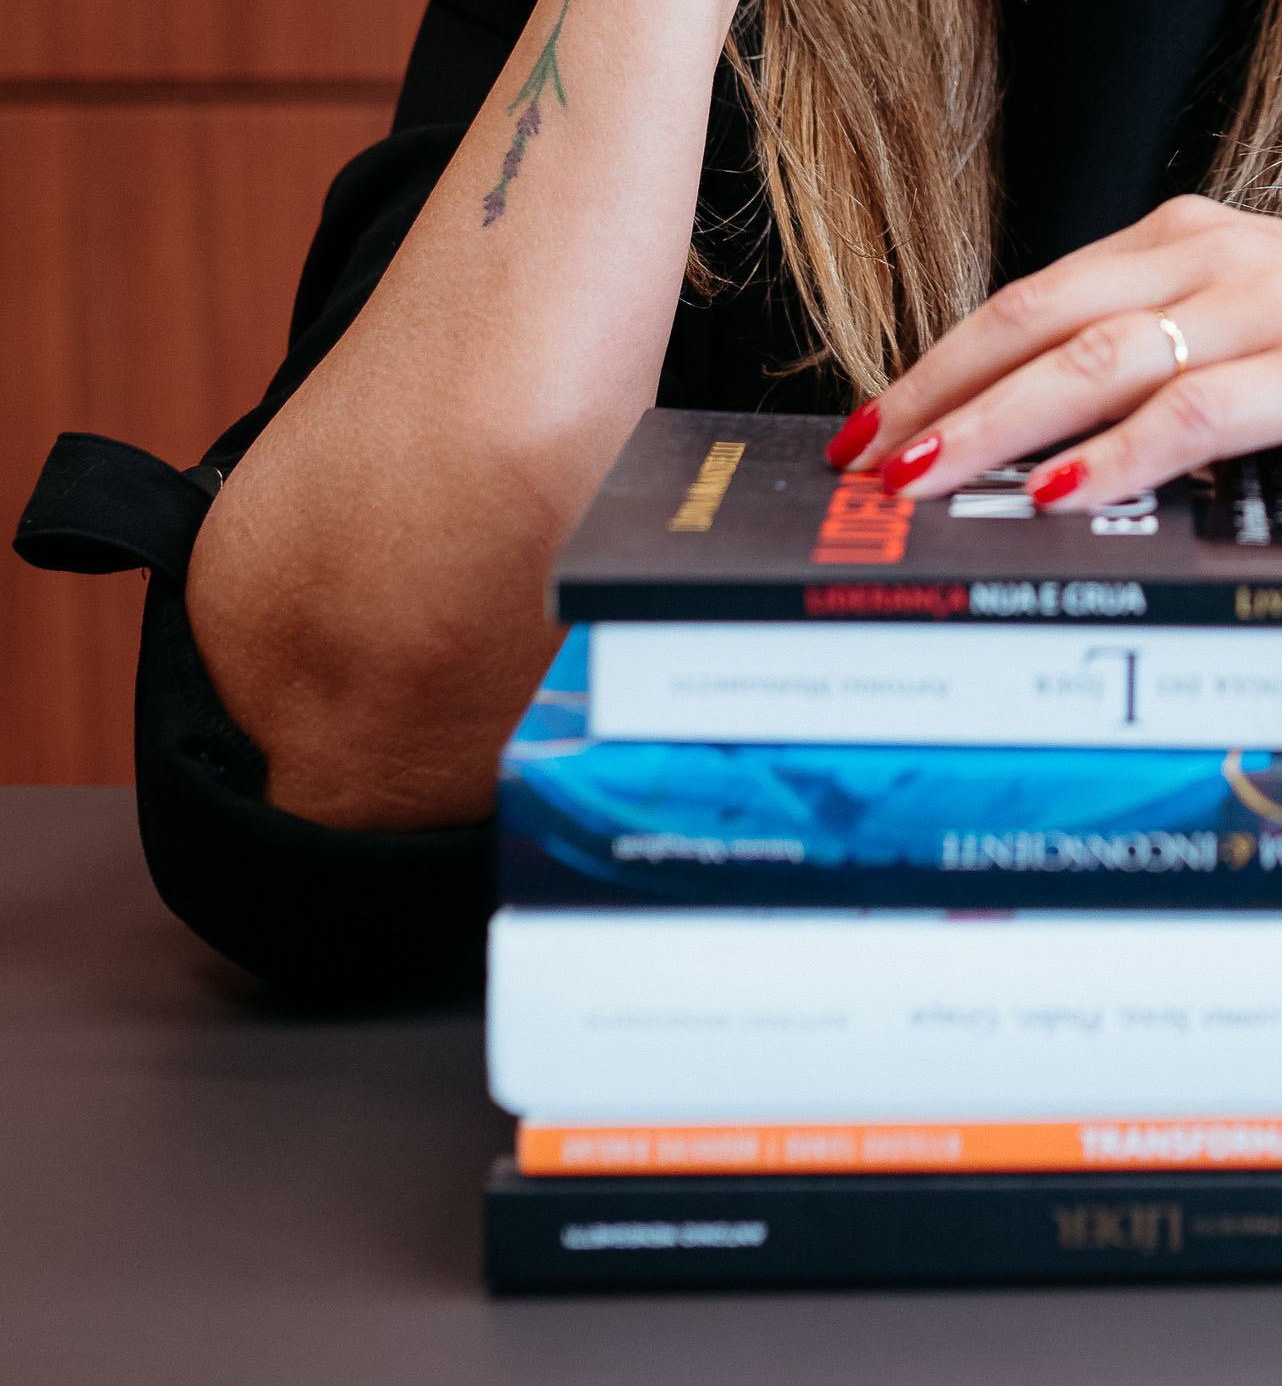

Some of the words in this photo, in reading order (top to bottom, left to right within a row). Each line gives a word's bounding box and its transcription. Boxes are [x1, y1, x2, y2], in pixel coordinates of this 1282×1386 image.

[969, 581, 1038, 617] NUA
[1039, 581, 1061, 616] E
[1061, 580, 1147, 616] CRUA
